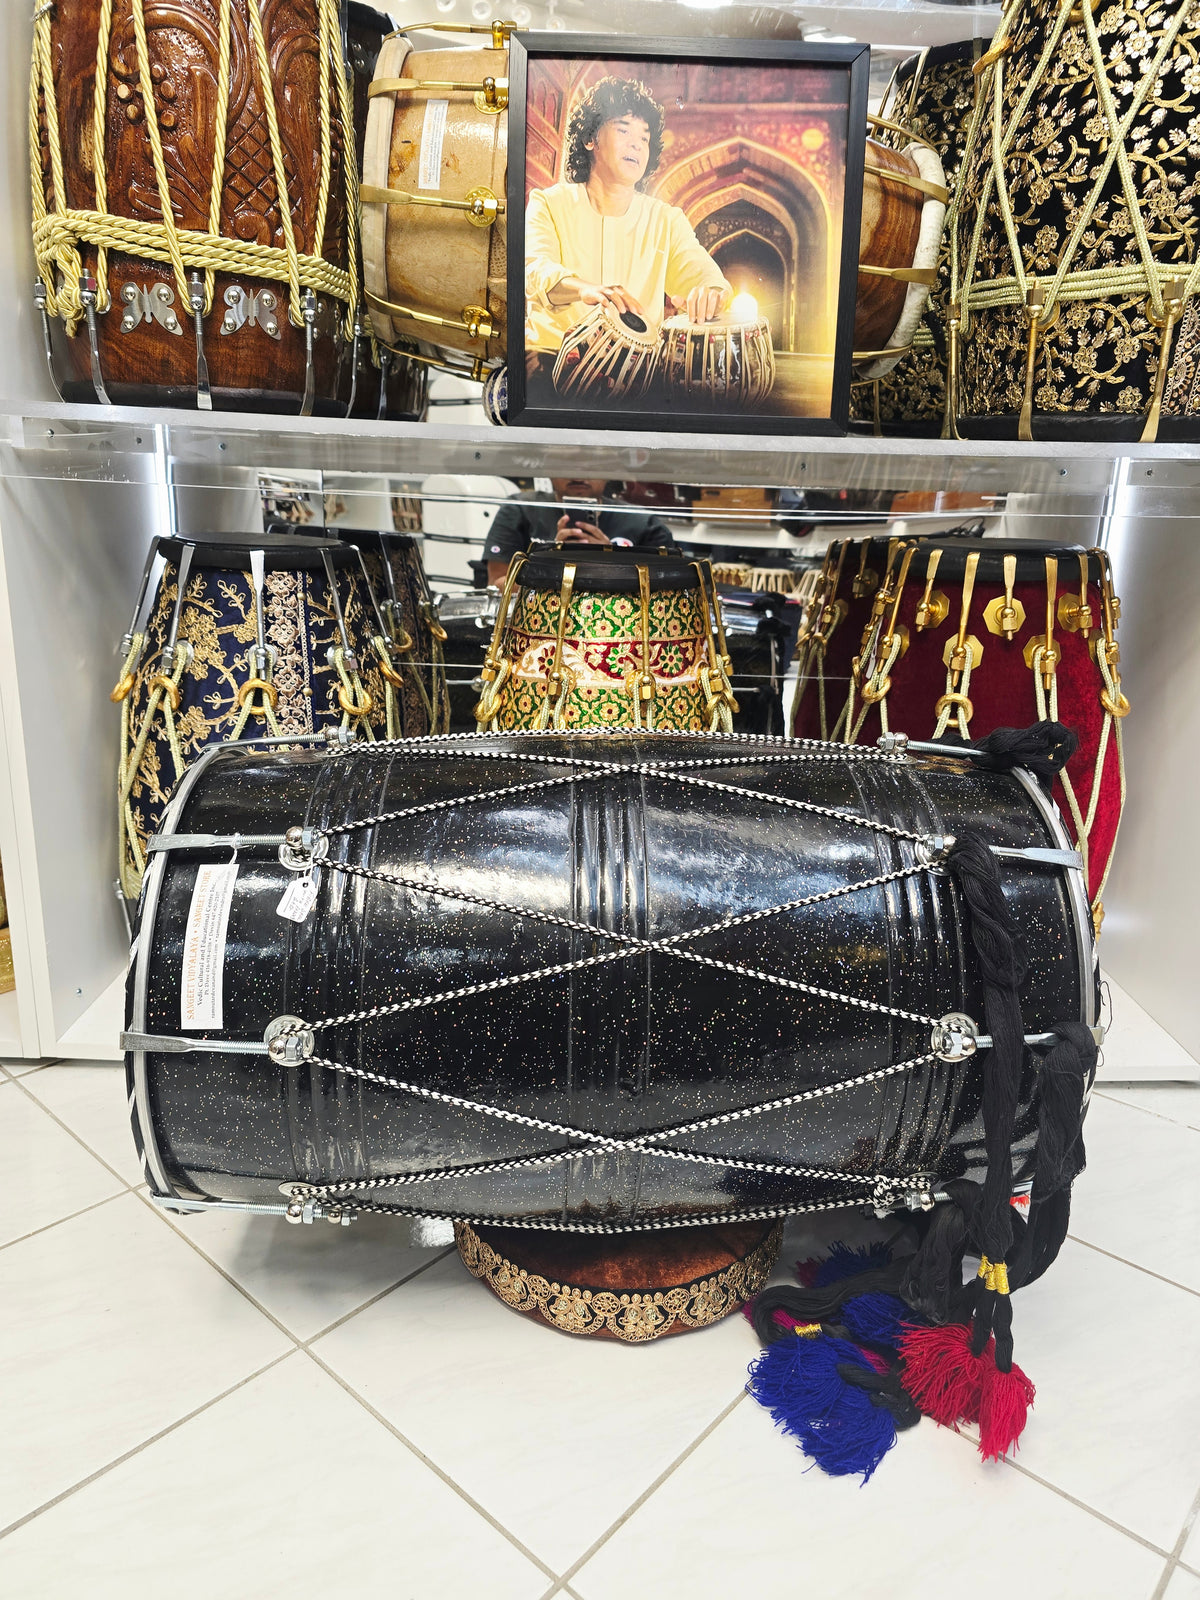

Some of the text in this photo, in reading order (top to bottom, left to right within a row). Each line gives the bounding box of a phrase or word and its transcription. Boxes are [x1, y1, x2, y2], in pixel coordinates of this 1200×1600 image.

[187, 937, 198, 981] VIDYALAYA
[193, 895, 204, 928] SANGEET
[200, 871, 212, 892] STORE
